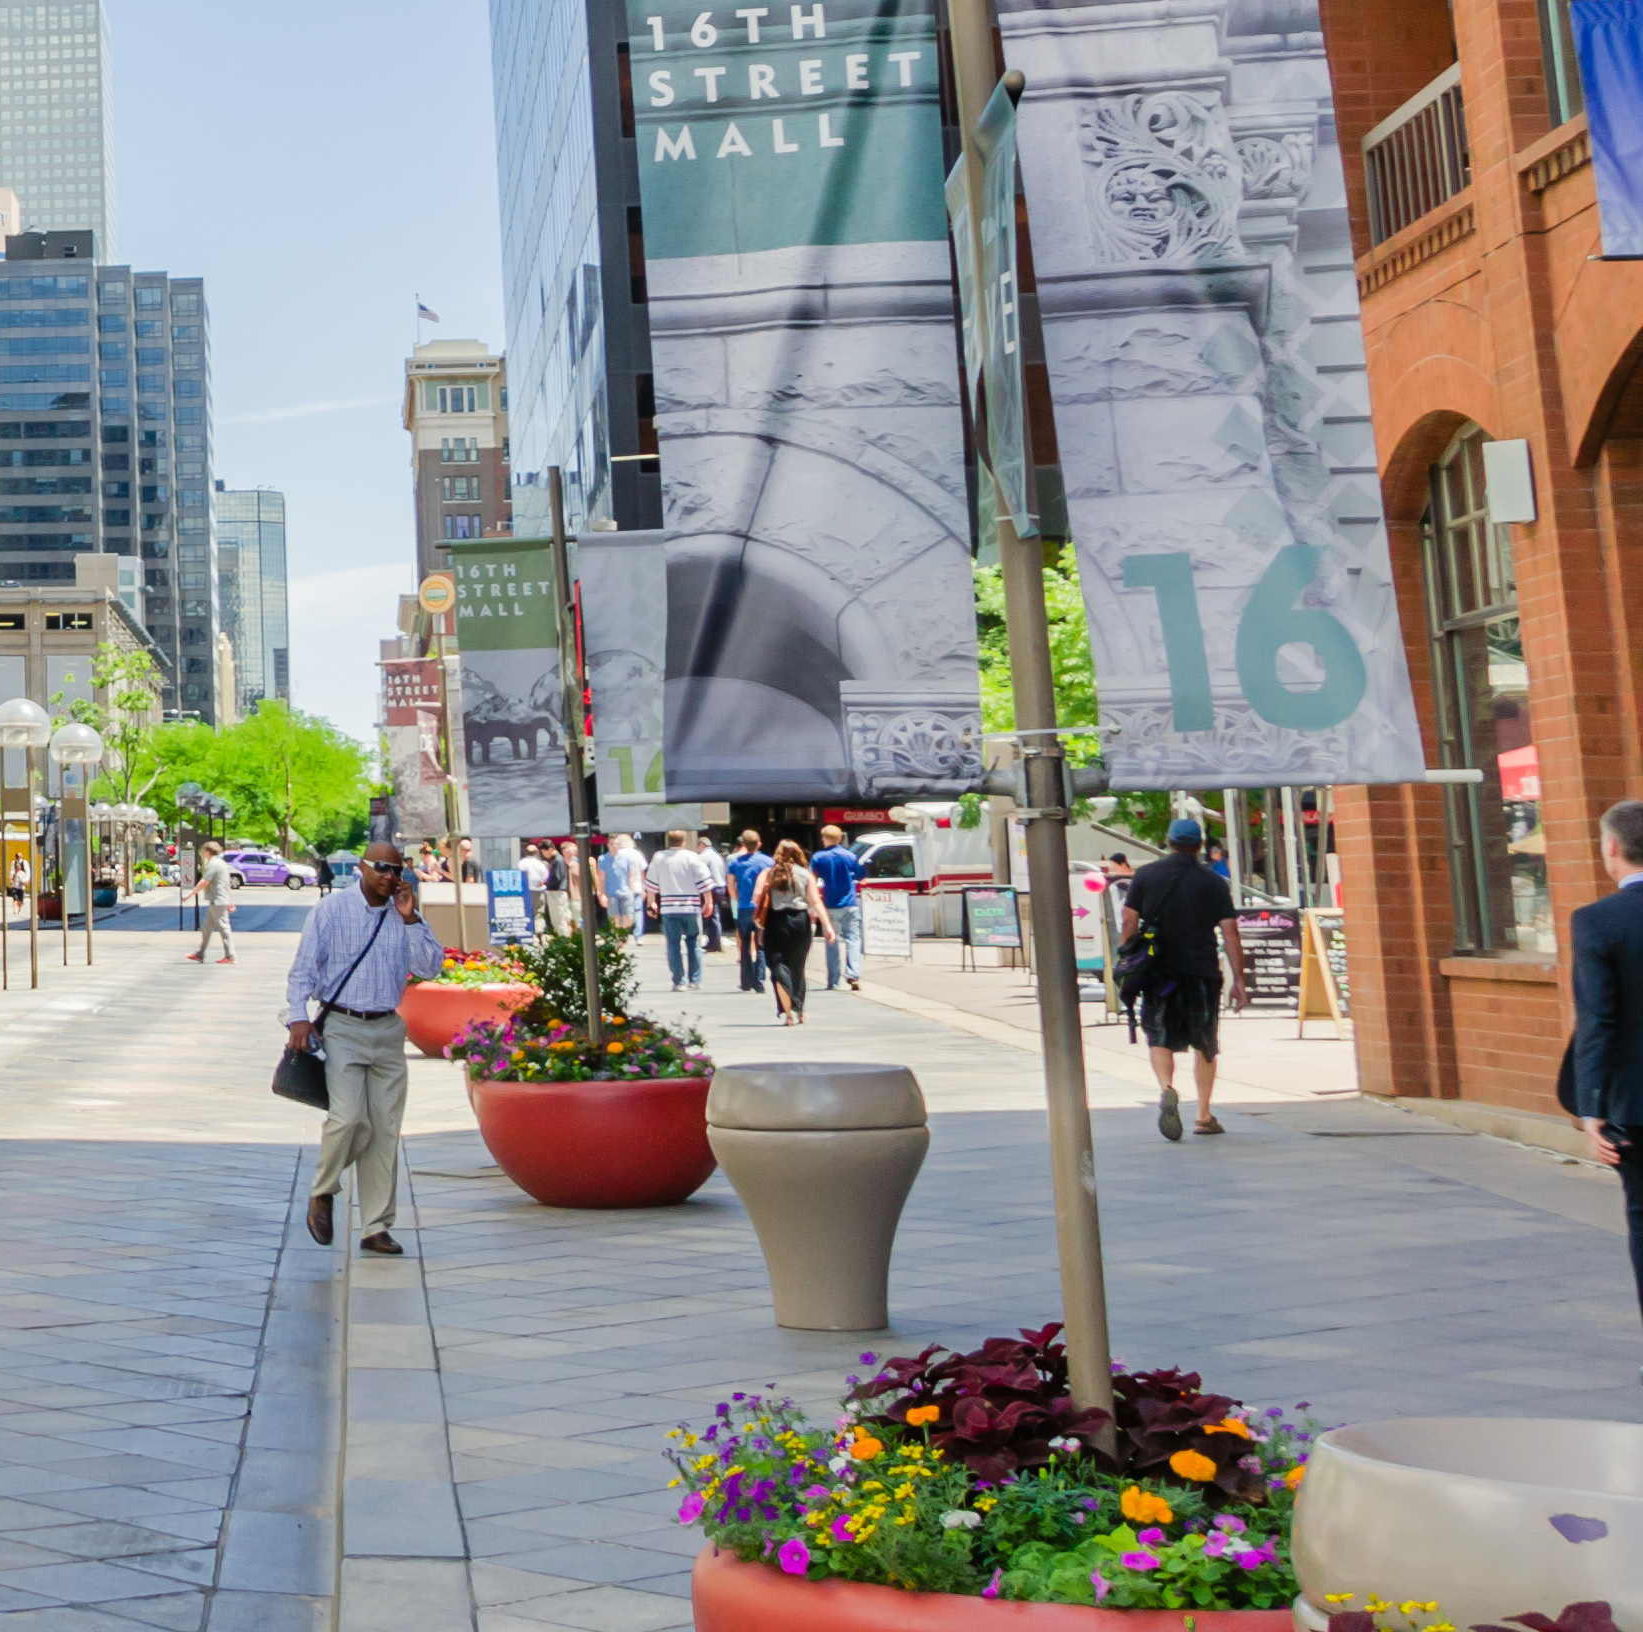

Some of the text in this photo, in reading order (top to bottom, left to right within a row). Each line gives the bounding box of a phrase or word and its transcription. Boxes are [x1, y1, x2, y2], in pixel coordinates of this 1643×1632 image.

[646, 3, 827, 52] 16TH
[647, 51, 921, 107] STREET
[653, 113, 845, 162] MALL
[456, 563, 516, 579] 16TH
[457, 581, 550, 599] STREET
[459, 602, 524, 618] MALL
[1122, 544, 1367, 732] 16
[388, 674, 421, 685] 16TH
[388, 685, 439, 696] STREET
[865, 892, 892, 903] Nail
